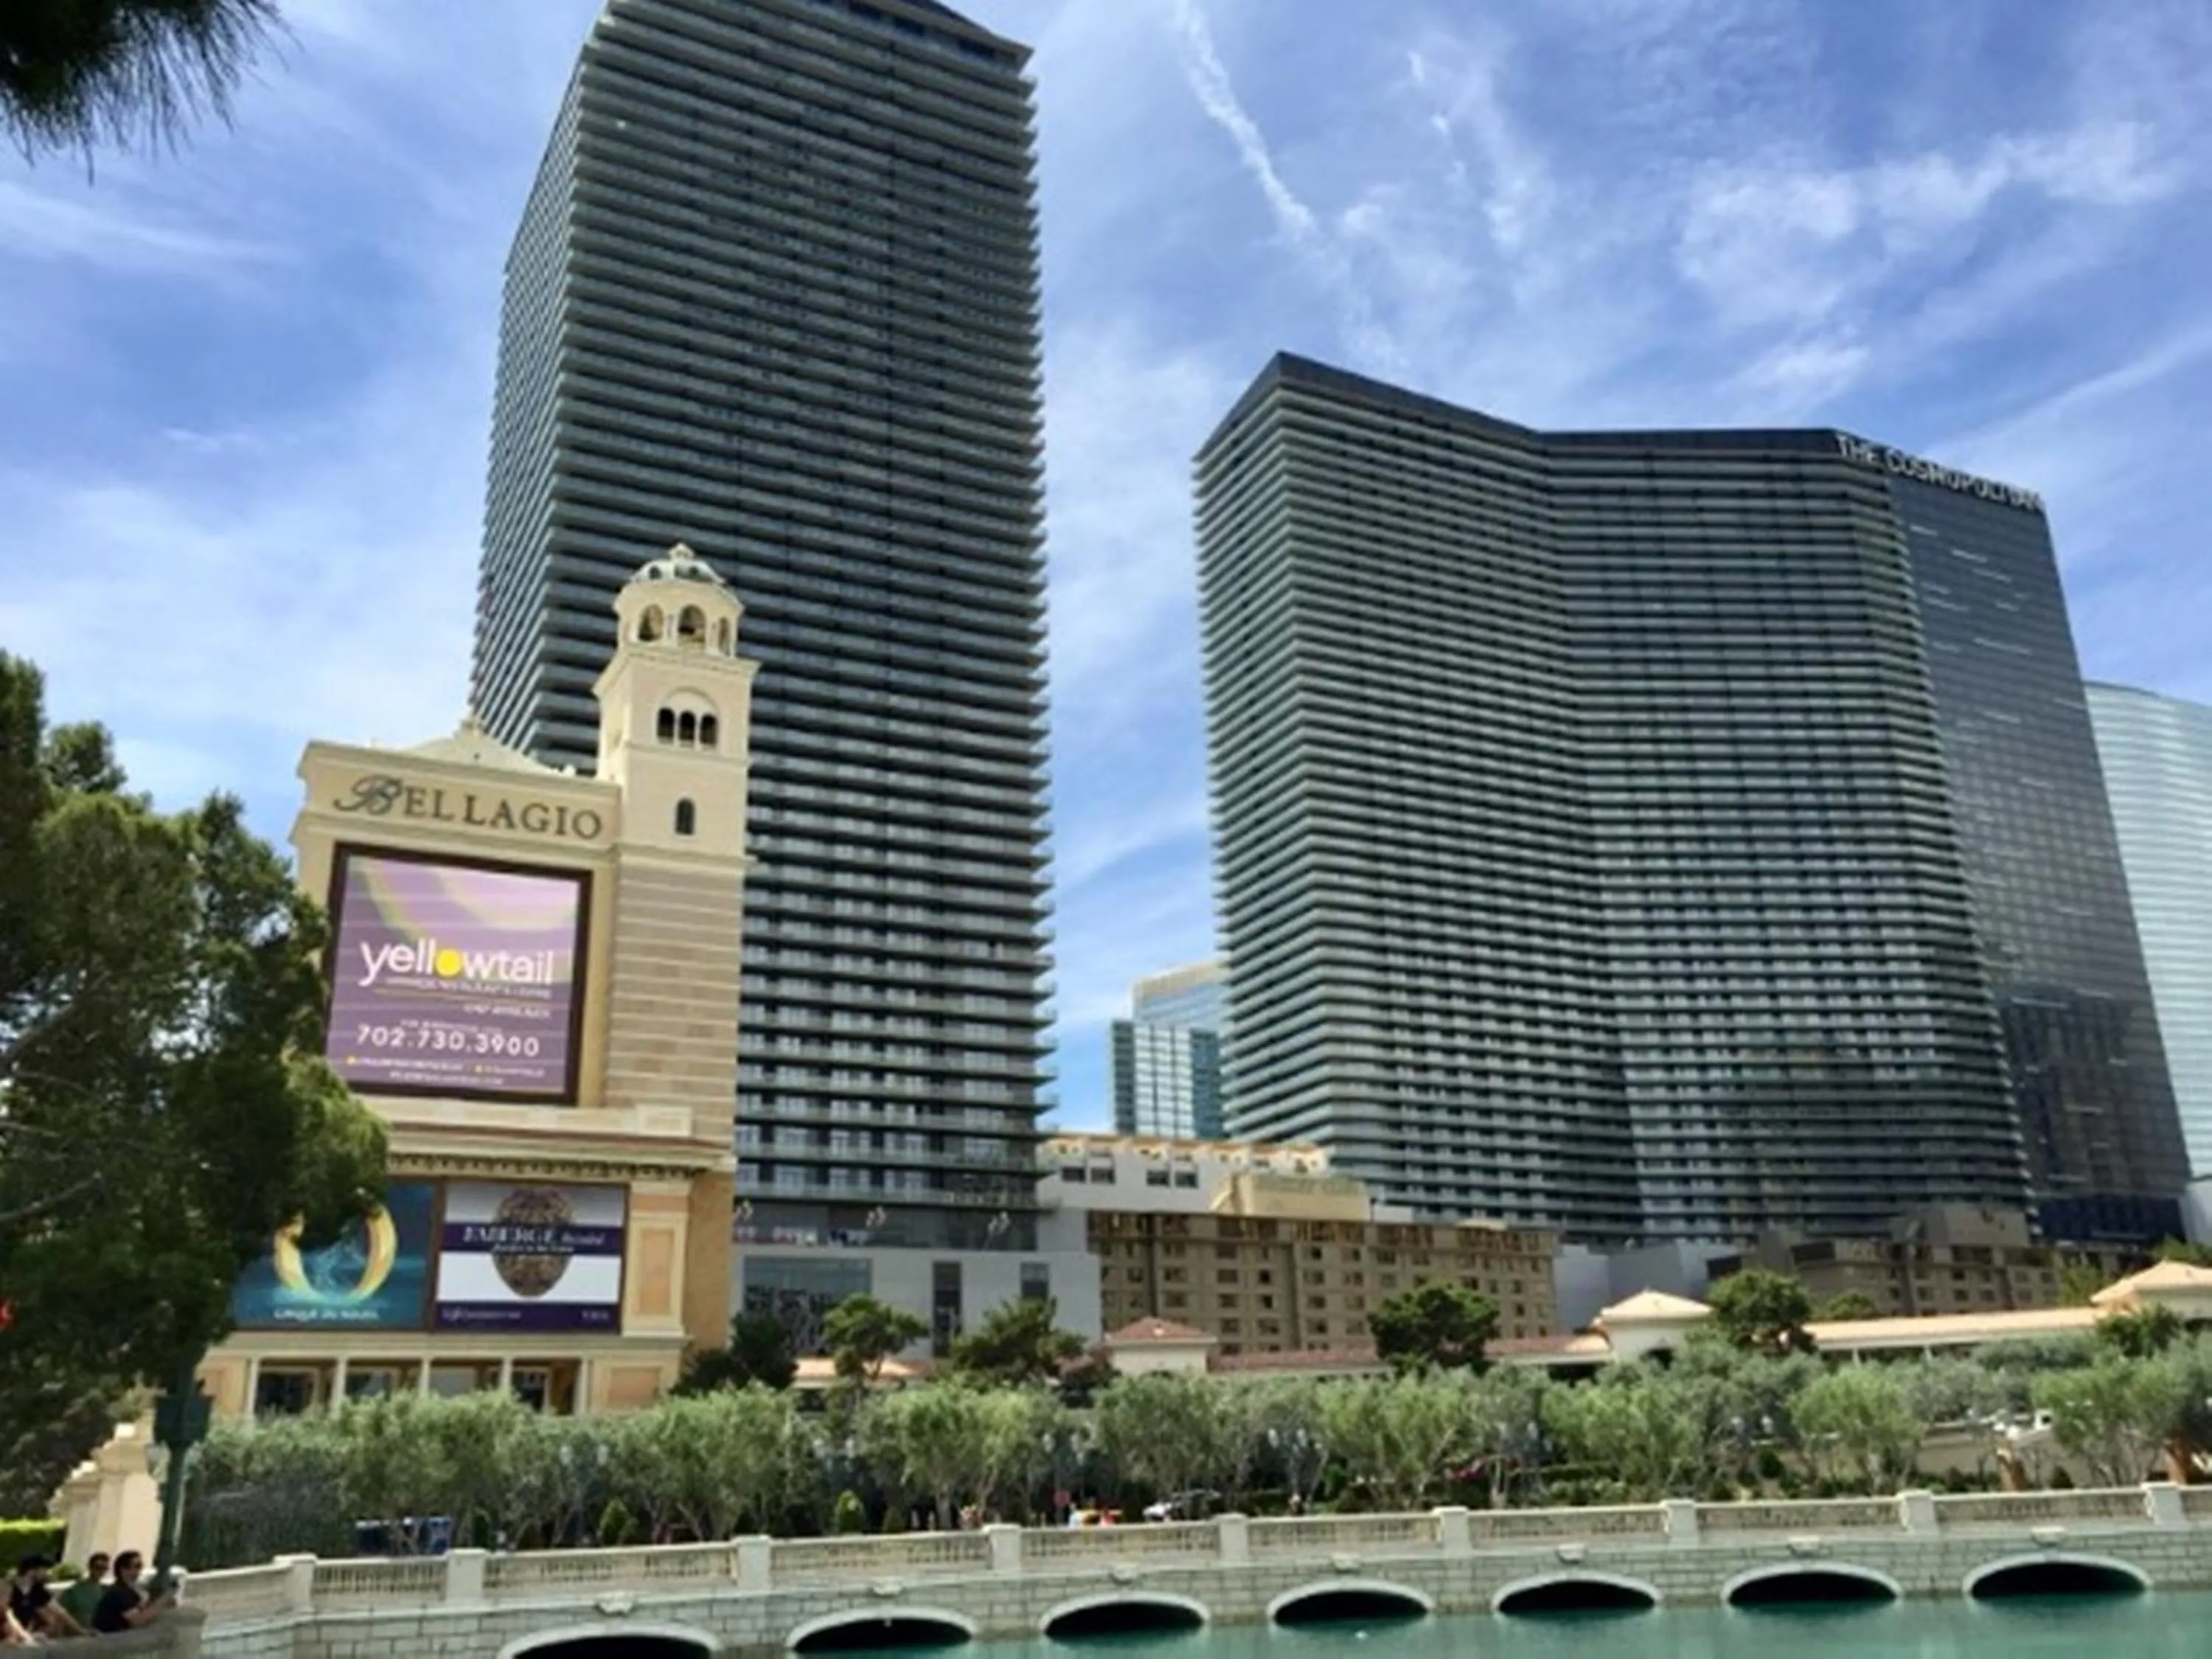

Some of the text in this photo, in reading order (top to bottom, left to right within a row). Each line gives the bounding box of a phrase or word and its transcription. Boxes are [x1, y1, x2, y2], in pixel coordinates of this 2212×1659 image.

[1836, 433, 1877, 465] THE
[333, 774, 602, 840] BELLAGIO
[358, 937, 554, 987] yellowtail
[357, 1024, 540, 1057] 702.730.3900
